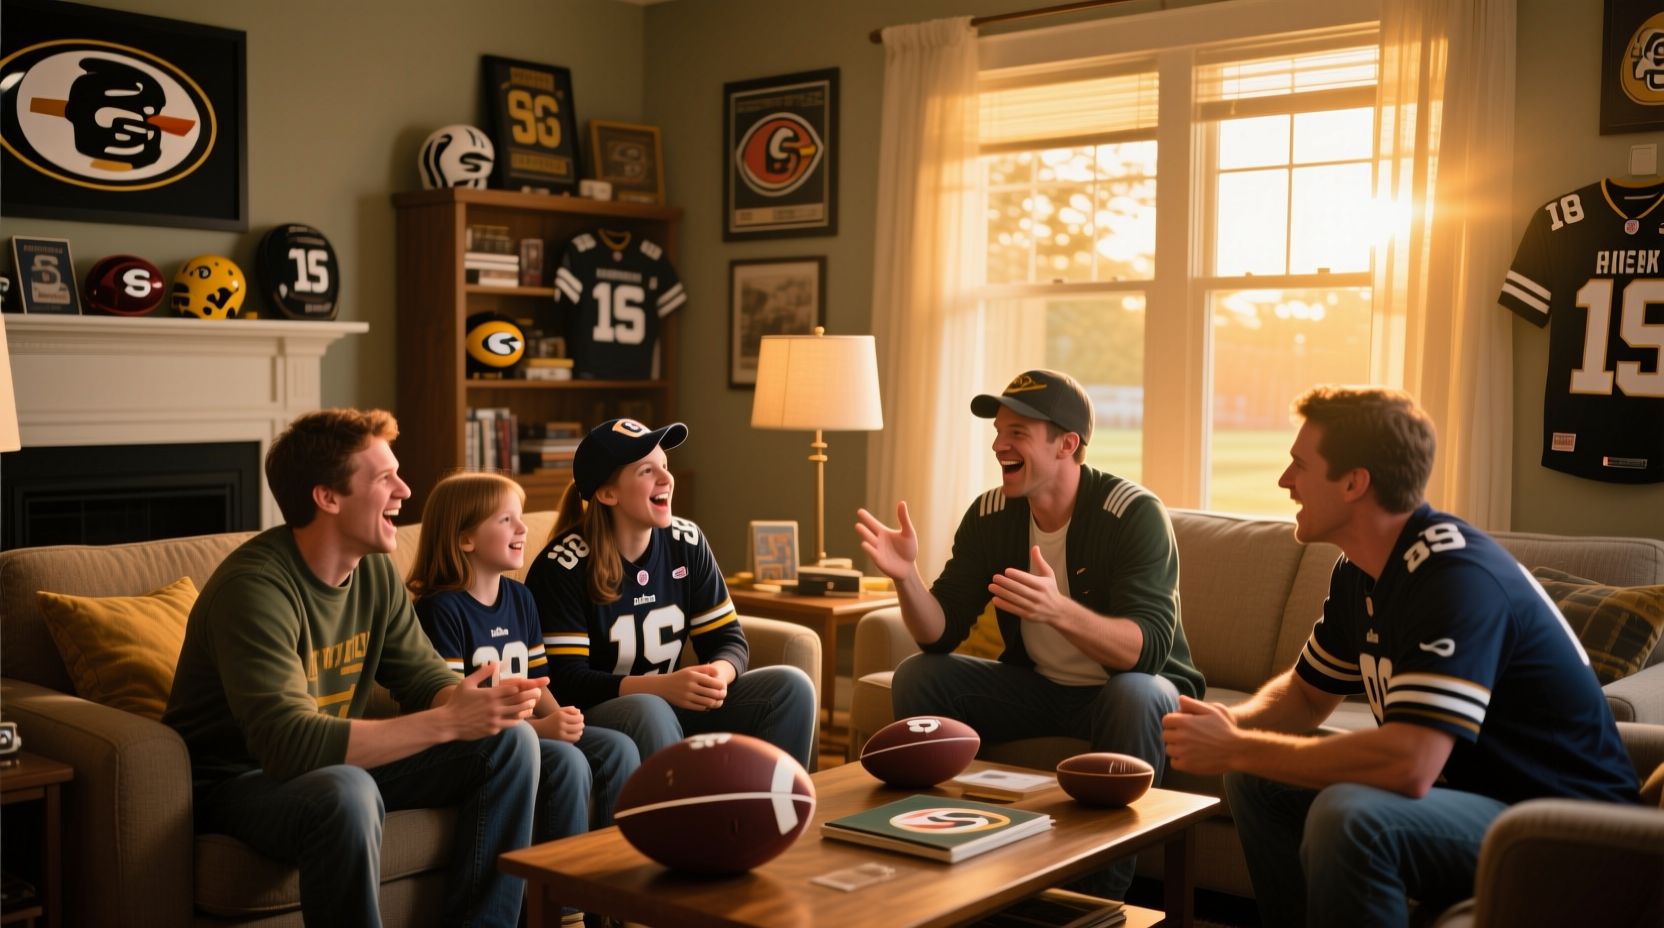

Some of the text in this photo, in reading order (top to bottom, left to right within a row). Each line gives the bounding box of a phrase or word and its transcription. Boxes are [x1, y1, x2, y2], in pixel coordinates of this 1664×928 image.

[1544, 193, 1585, 232] 18
[122, 268, 151, 298] S
[288, 248, 329, 293] 15
[592, 282, 646, 345] 15
